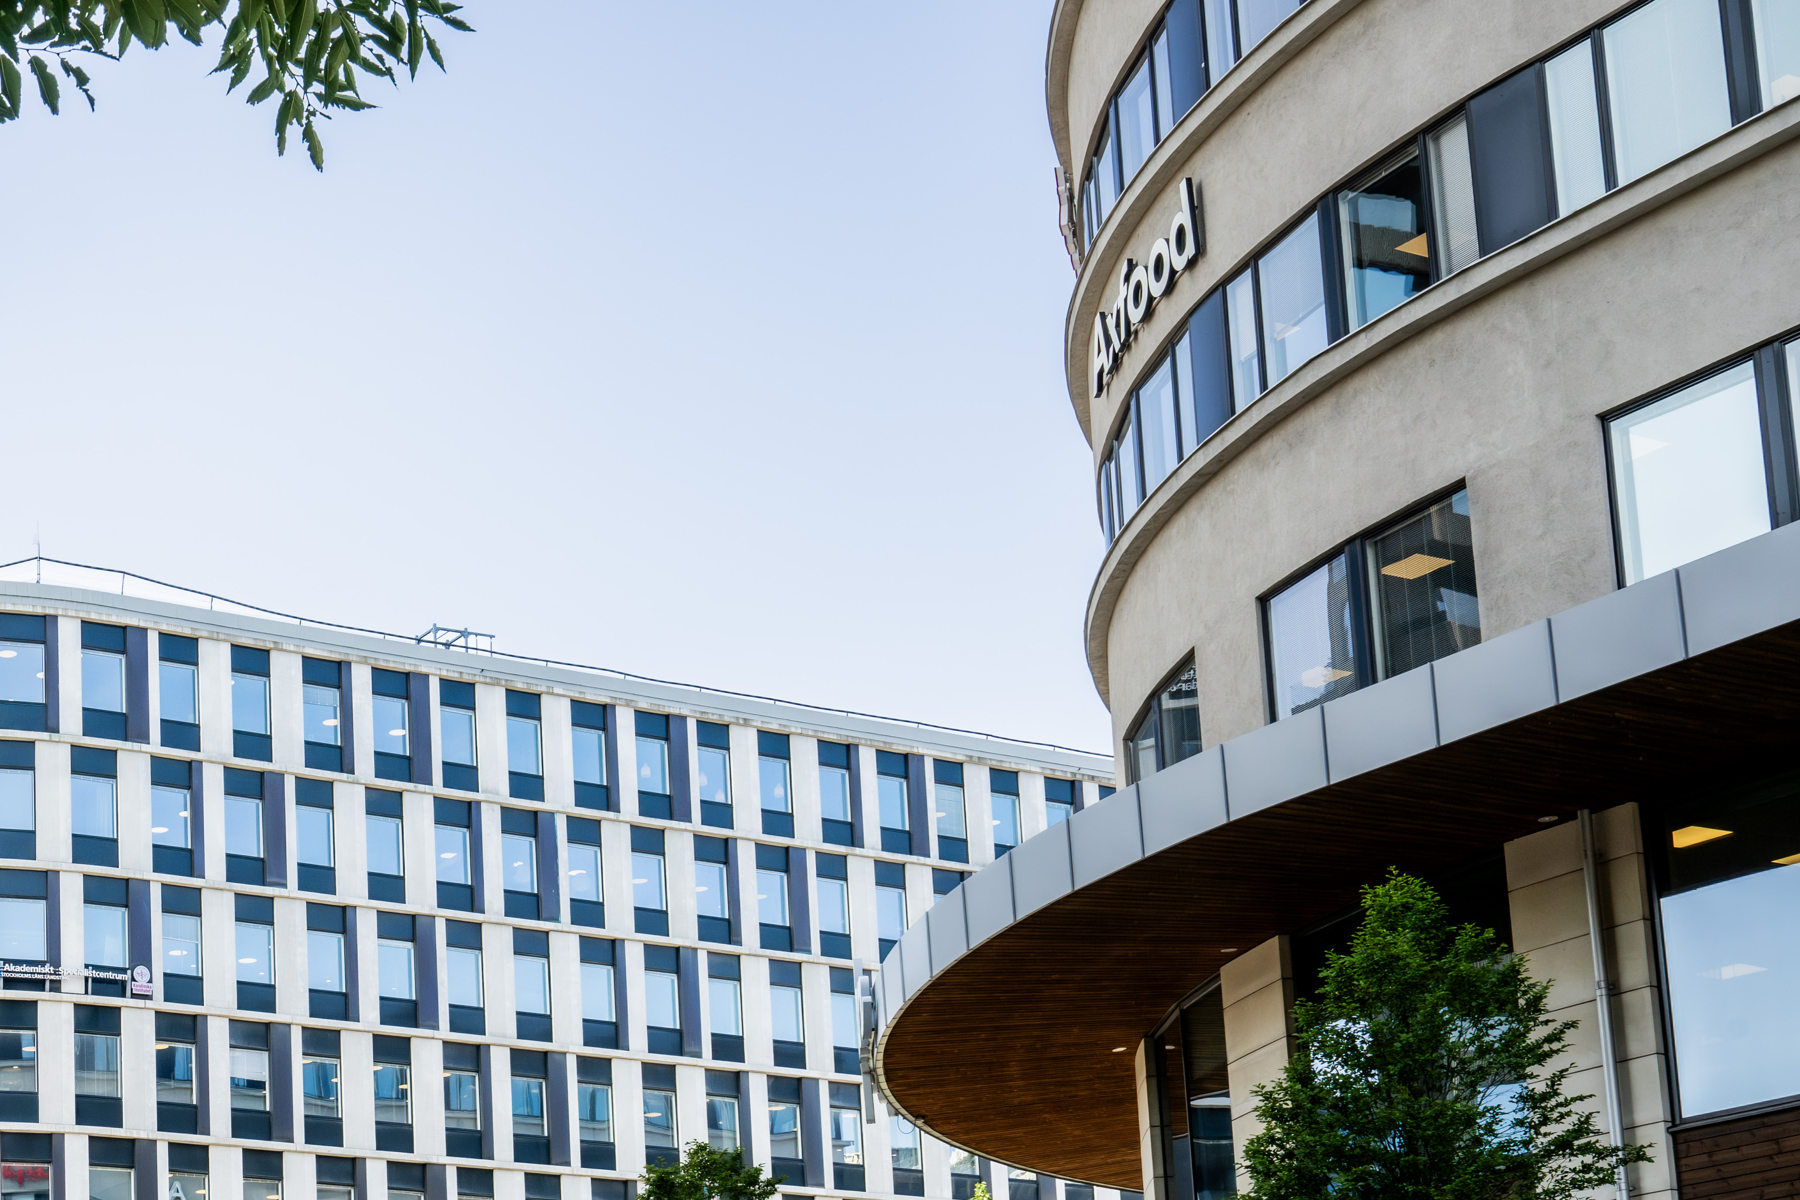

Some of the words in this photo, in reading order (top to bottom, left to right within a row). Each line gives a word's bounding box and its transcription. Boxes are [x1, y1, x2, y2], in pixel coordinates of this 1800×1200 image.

[1094, 177, 1200, 398] Axfood
[3, 963, 54, 975] Akademiskt
[58, 967, 128, 980] Specialistcentrum
